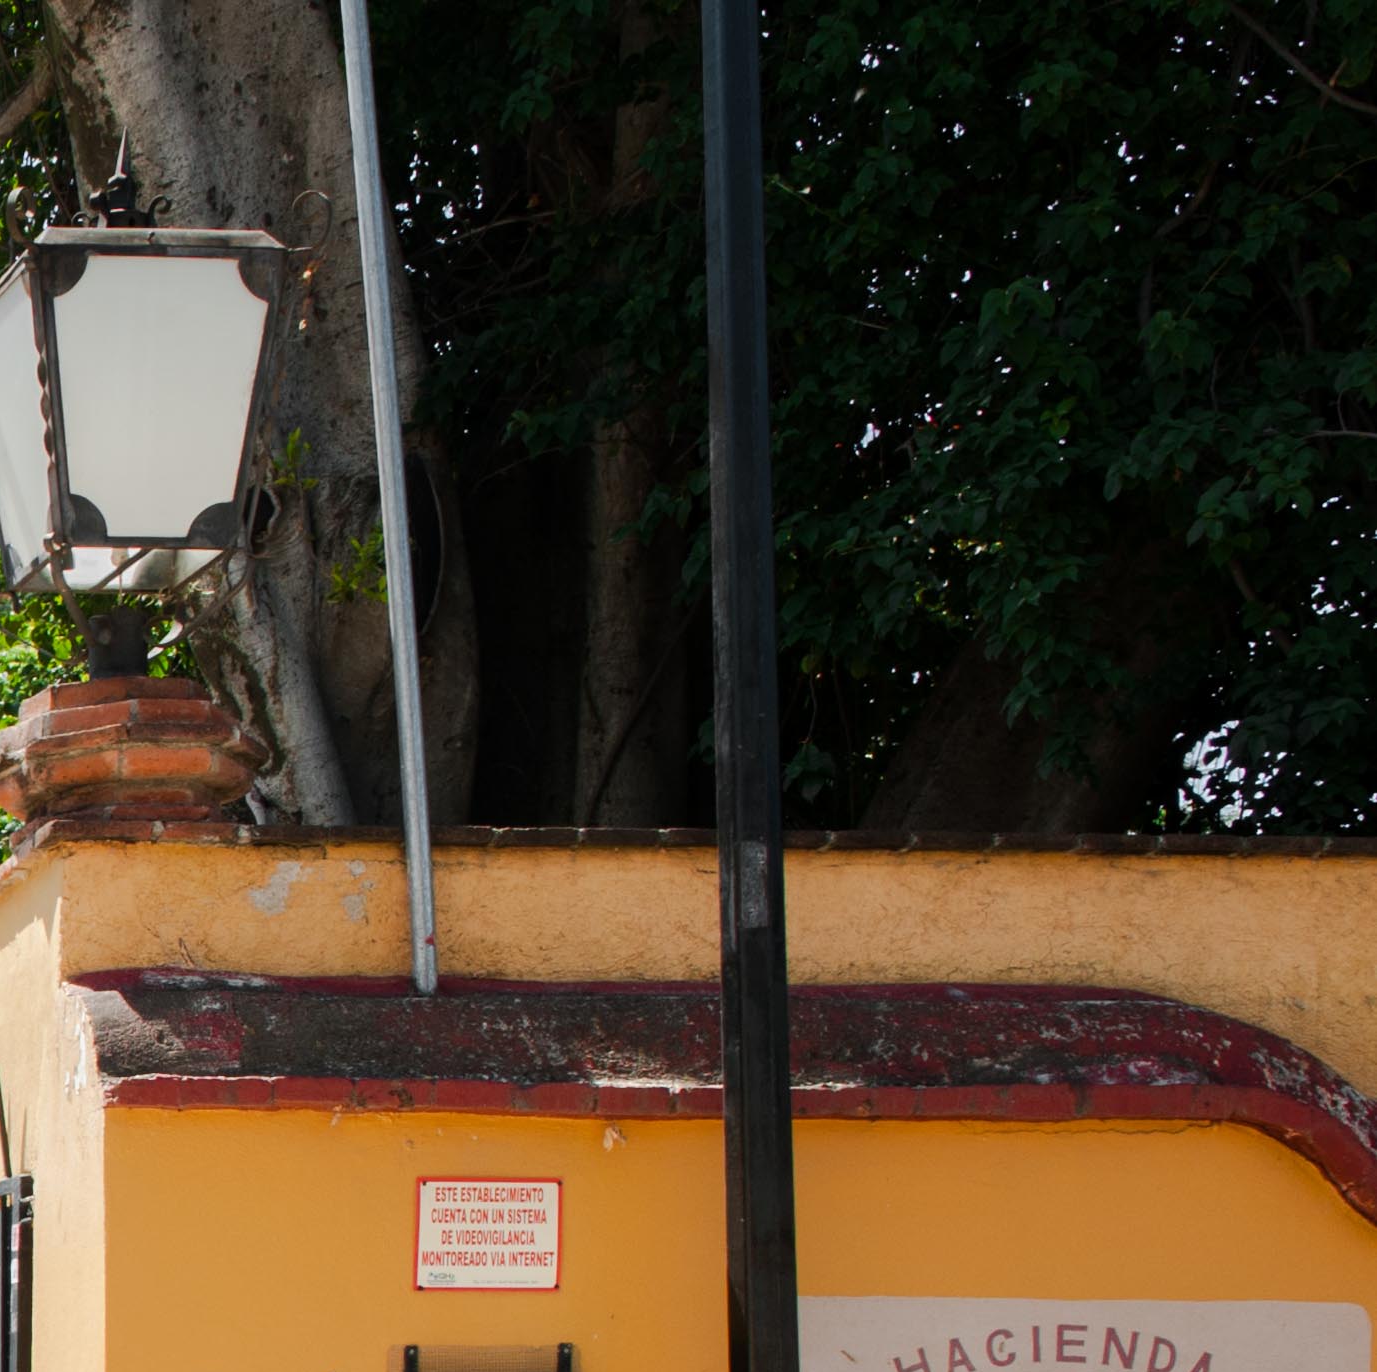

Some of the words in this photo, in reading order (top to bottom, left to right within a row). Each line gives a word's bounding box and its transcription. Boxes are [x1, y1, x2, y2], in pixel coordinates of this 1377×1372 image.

[435, 1187, 458, 1202] ESTE
[460, 1187, 544, 1203] ESTABLECIMIENTO
[431, 1209, 467, 1224] CUENTA
[469, 1209, 488, 1224] CON
[491, 1209, 504, 1224] UN
[507, 1209, 547, 1225] SISTEMA
[441, 1230, 453, 1245] DE
[455, 1230, 536, 1245] VIDEOVIGILANCIA
[421, 1252, 488, 1267] MONITOREADO
[490, 1252, 506, 1267] VIA
[508, 1252, 555, 1267] INTERNET
